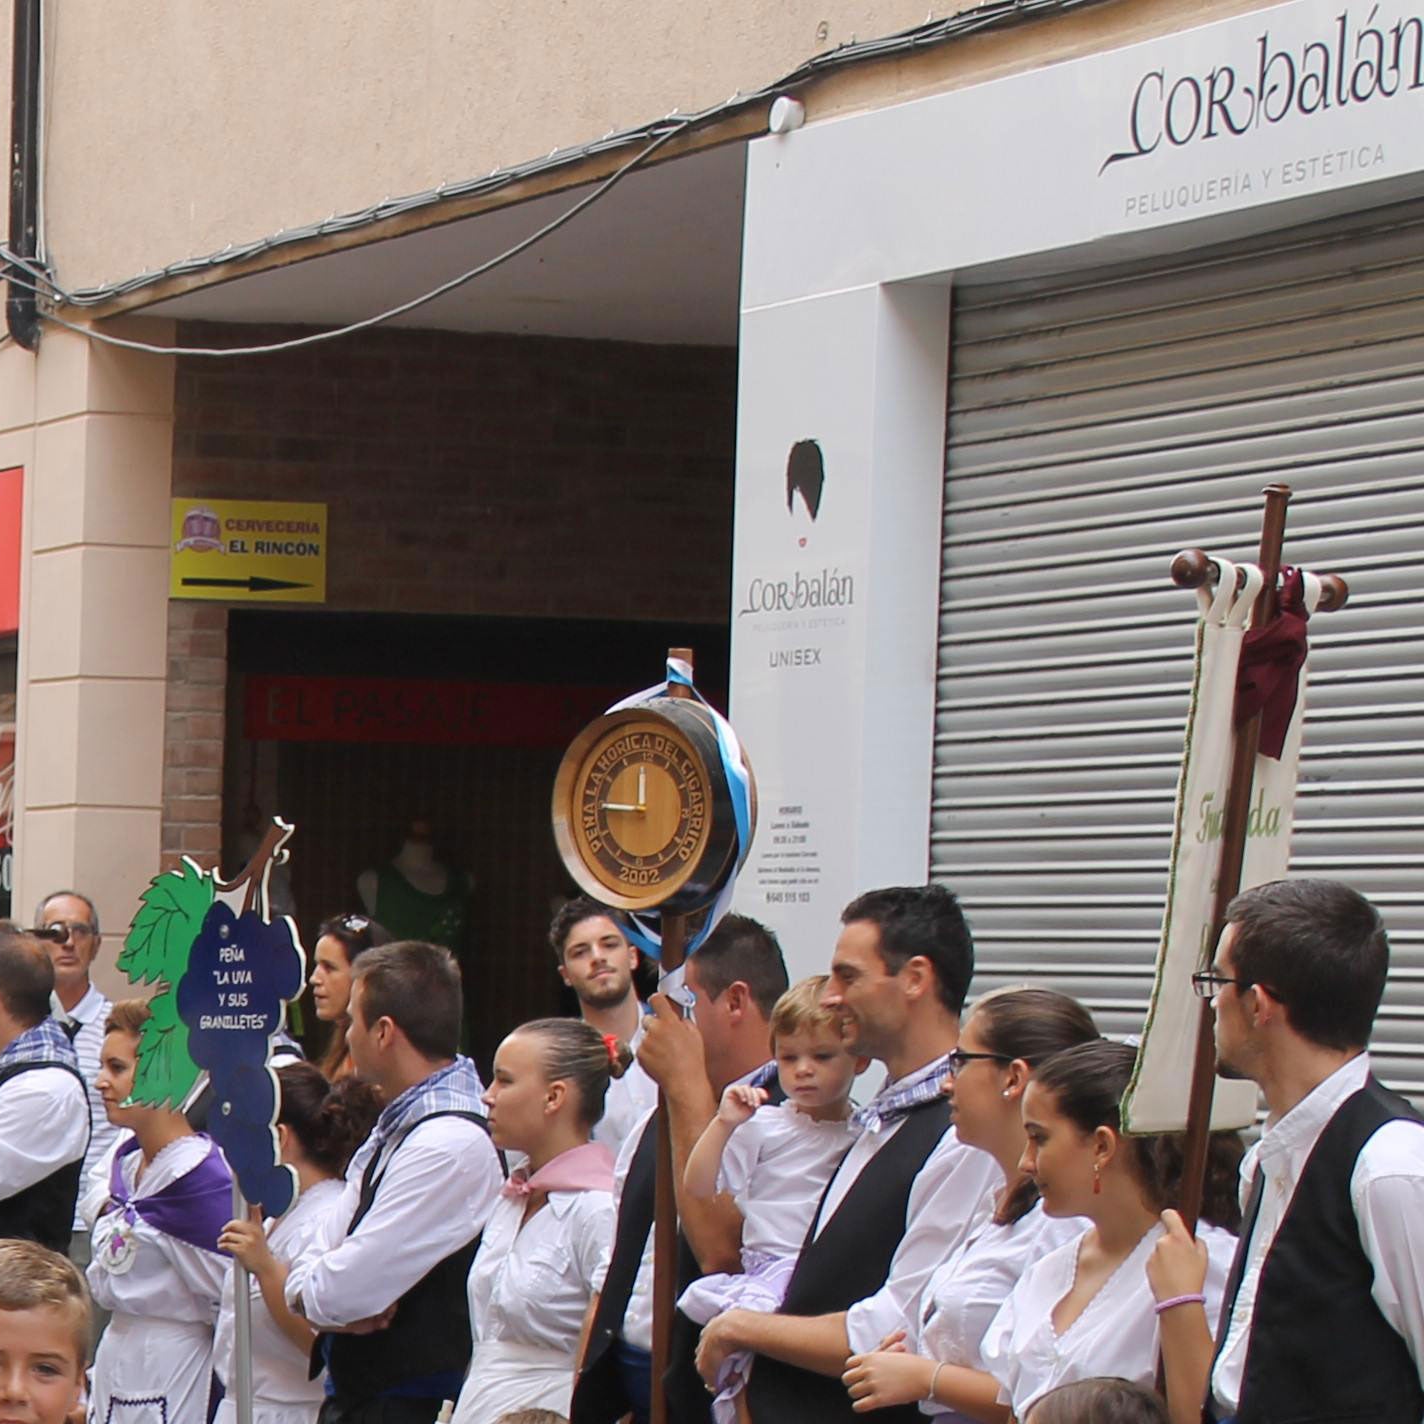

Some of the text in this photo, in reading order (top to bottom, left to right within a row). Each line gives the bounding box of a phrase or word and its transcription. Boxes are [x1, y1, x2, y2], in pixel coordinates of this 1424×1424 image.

[1124, 144, 1385, 217] PELUQUERÍA Y ESTÉTICA
[225, 518, 320, 534] CERVECERÍA
[229, 540, 249, 553] EL
[769, 648, 822, 668] UNISEX
[586, 772, 602, 796] LA
[599, 735, 652, 770] HORICA
[655, 736, 683, 765] DEL
[679, 759, 704, 861] CIGARRICO
[619, 867, 661, 884] 2002
[219, 944, 245, 963] PEÑA
[232, 971, 252, 985] UVA
[218, 993, 248, 1008] Y SUS
